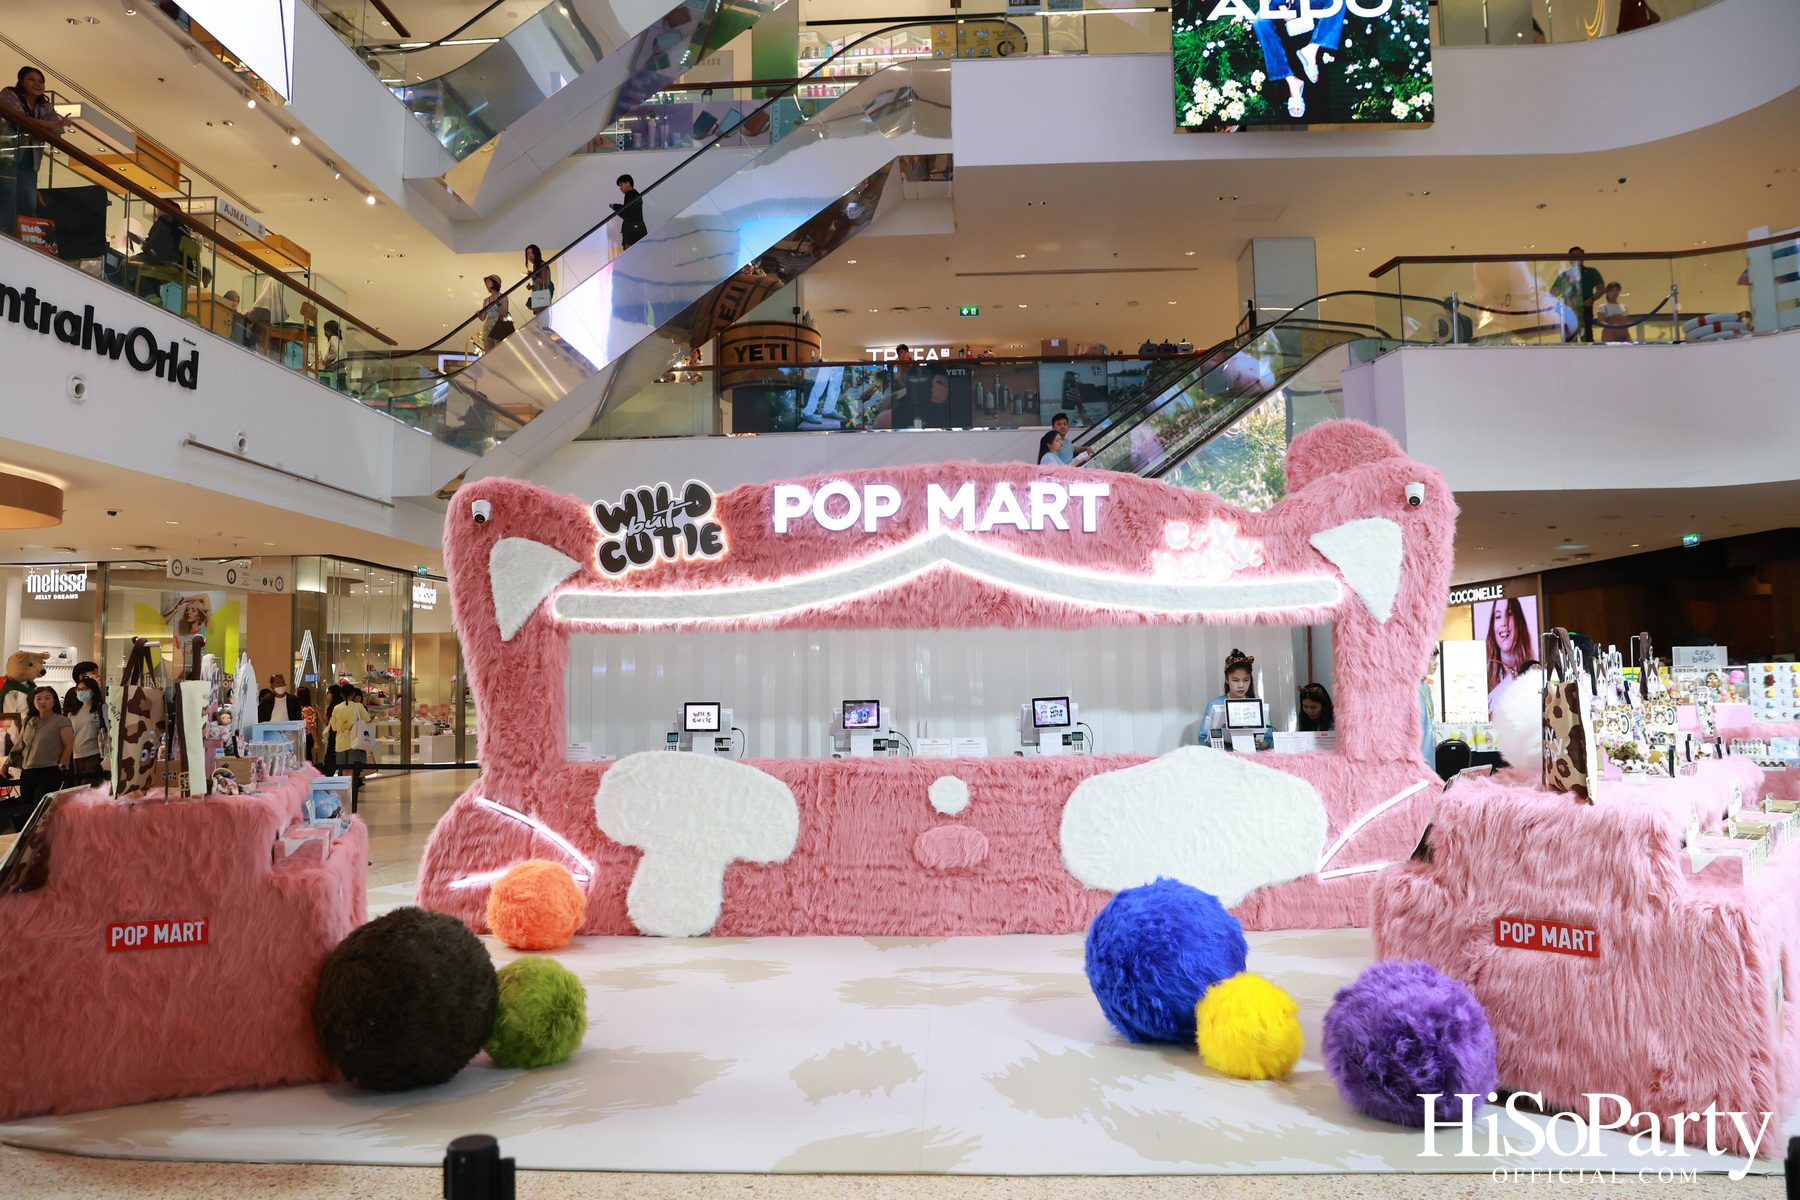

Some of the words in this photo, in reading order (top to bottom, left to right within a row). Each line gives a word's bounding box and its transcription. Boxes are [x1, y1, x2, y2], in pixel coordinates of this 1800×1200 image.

[224, 204, 249, 227] AJMAL
[734, 343, 789, 363] YETI
[596, 483, 712, 533] WILD
[774, 480, 902, 533] POP
[927, 481, 1110, 533] MART
[600, 522, 723, 573] CUTIE
[27, 569, 87, 593] melissa
[1449, 585, 1503, 604] COCCINELLE
[112, 925, 148, 947] POP
[154, 921, 205, 944] MART
[1500, 920, 1536, 944] POP
[1541, 925, 1595, 952] MART
